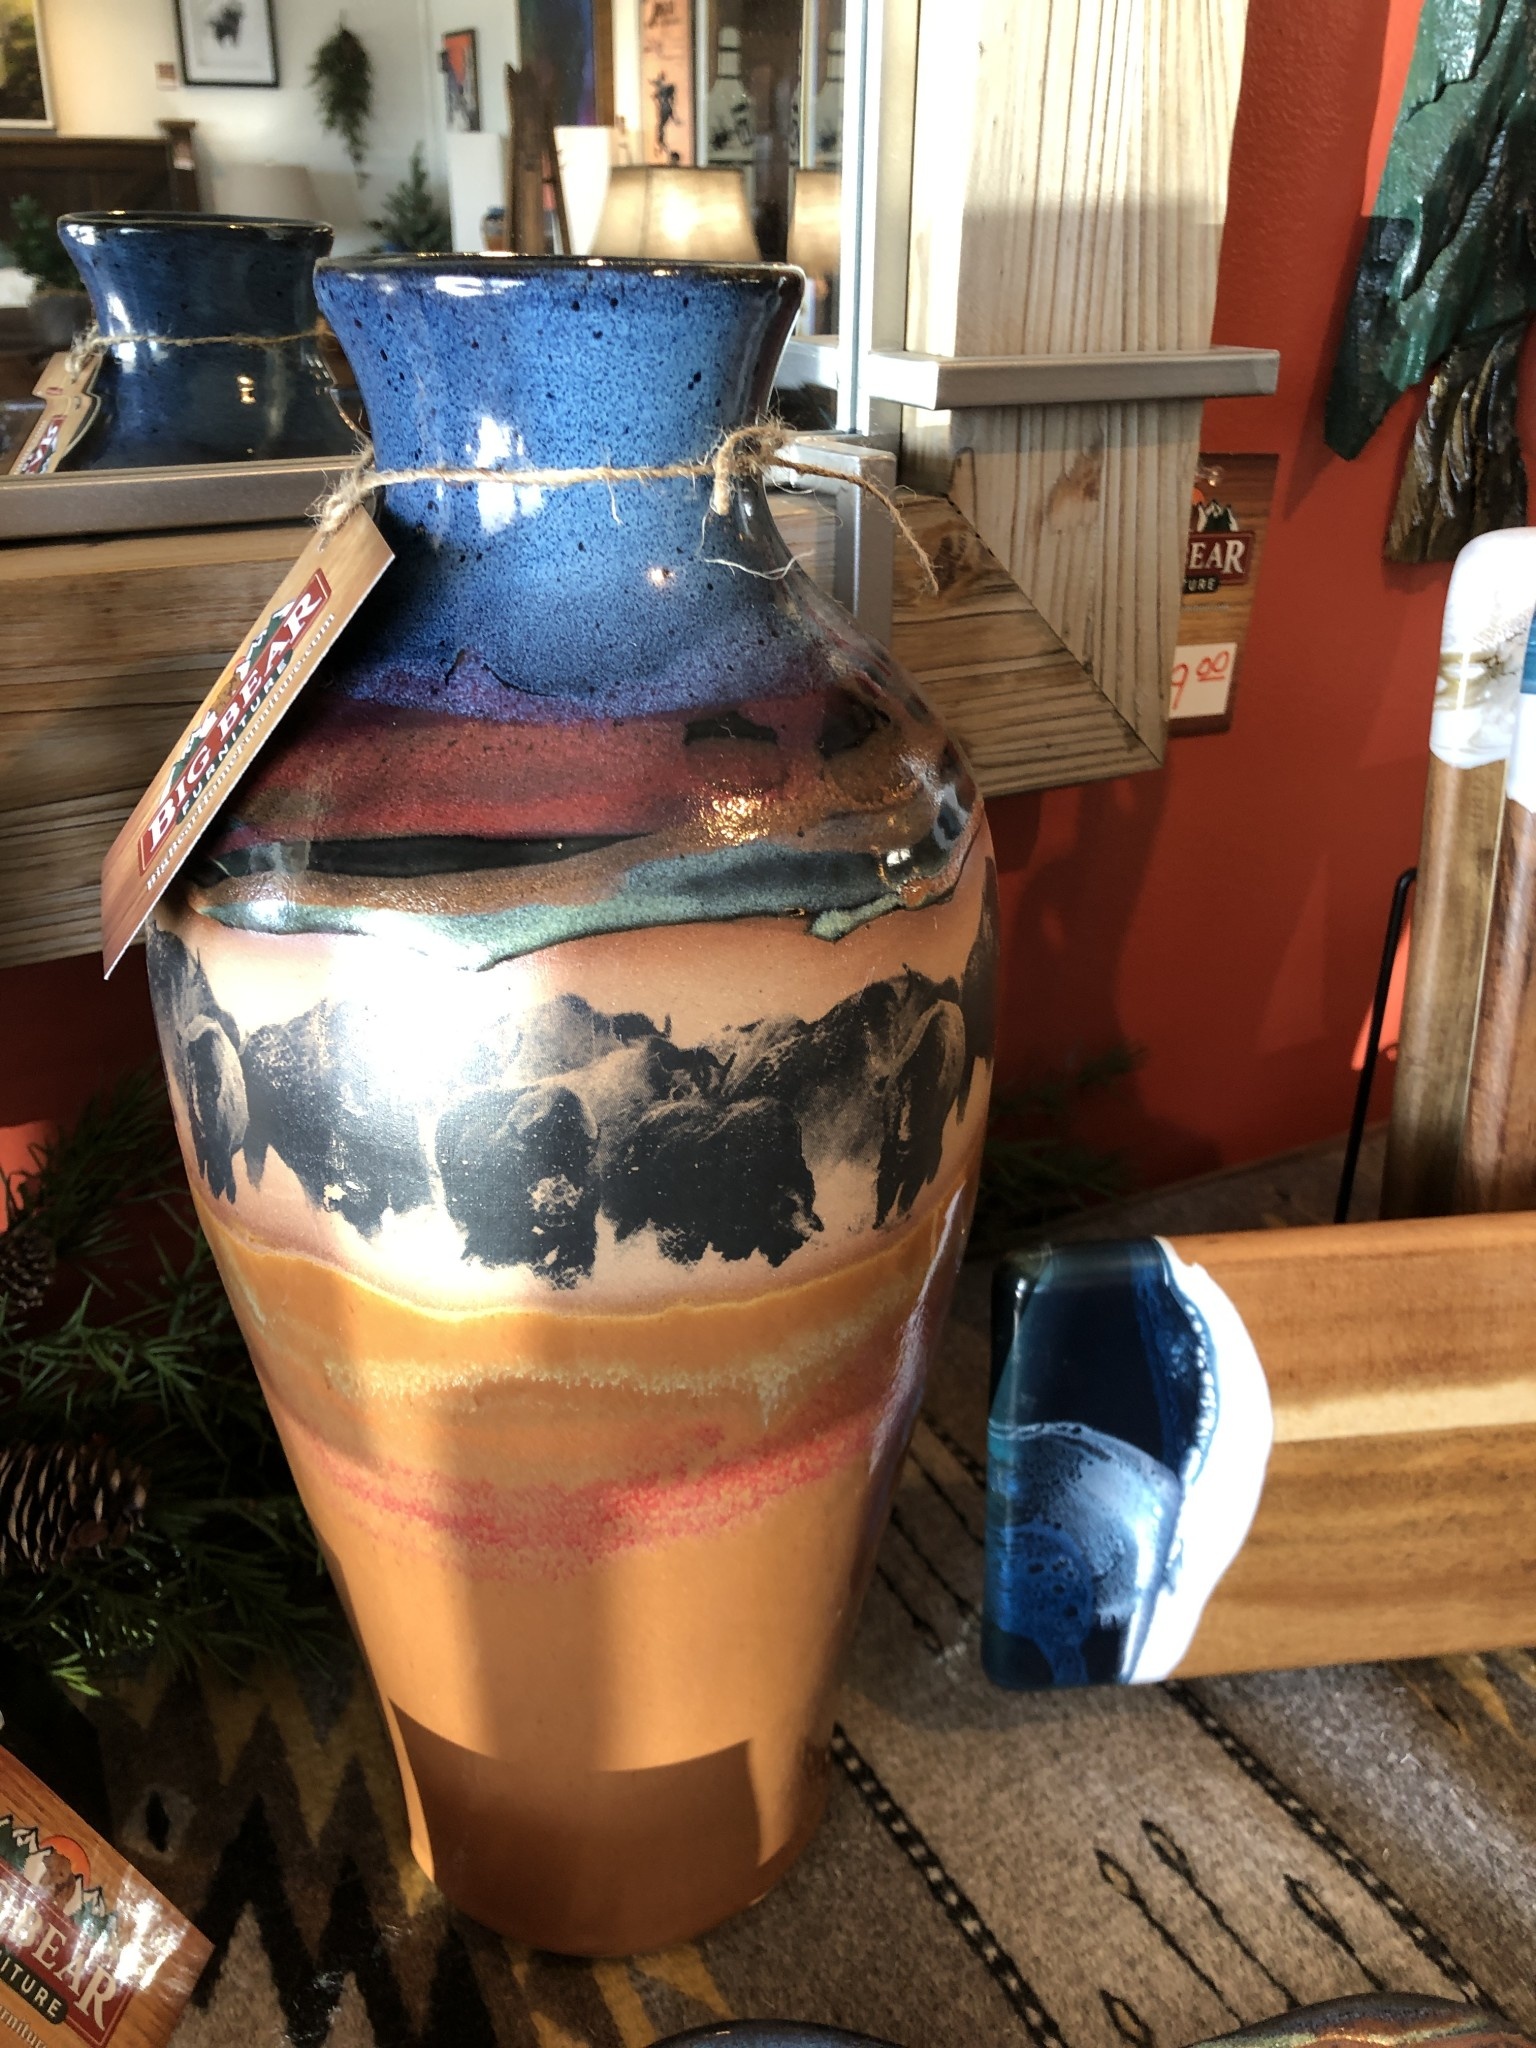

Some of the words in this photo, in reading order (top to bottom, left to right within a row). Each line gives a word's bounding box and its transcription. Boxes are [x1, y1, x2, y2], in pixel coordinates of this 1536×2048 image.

[1184, 577, 1217, 592] URE
[1188, 539, 1246, 575] EAR
[148, 745, 212, 853] BIG
[217, 592, 323, 742] BEAR
[182, 658, 288, 816] FURNITURE
[0, 1949, 62, 2018] ITURE
